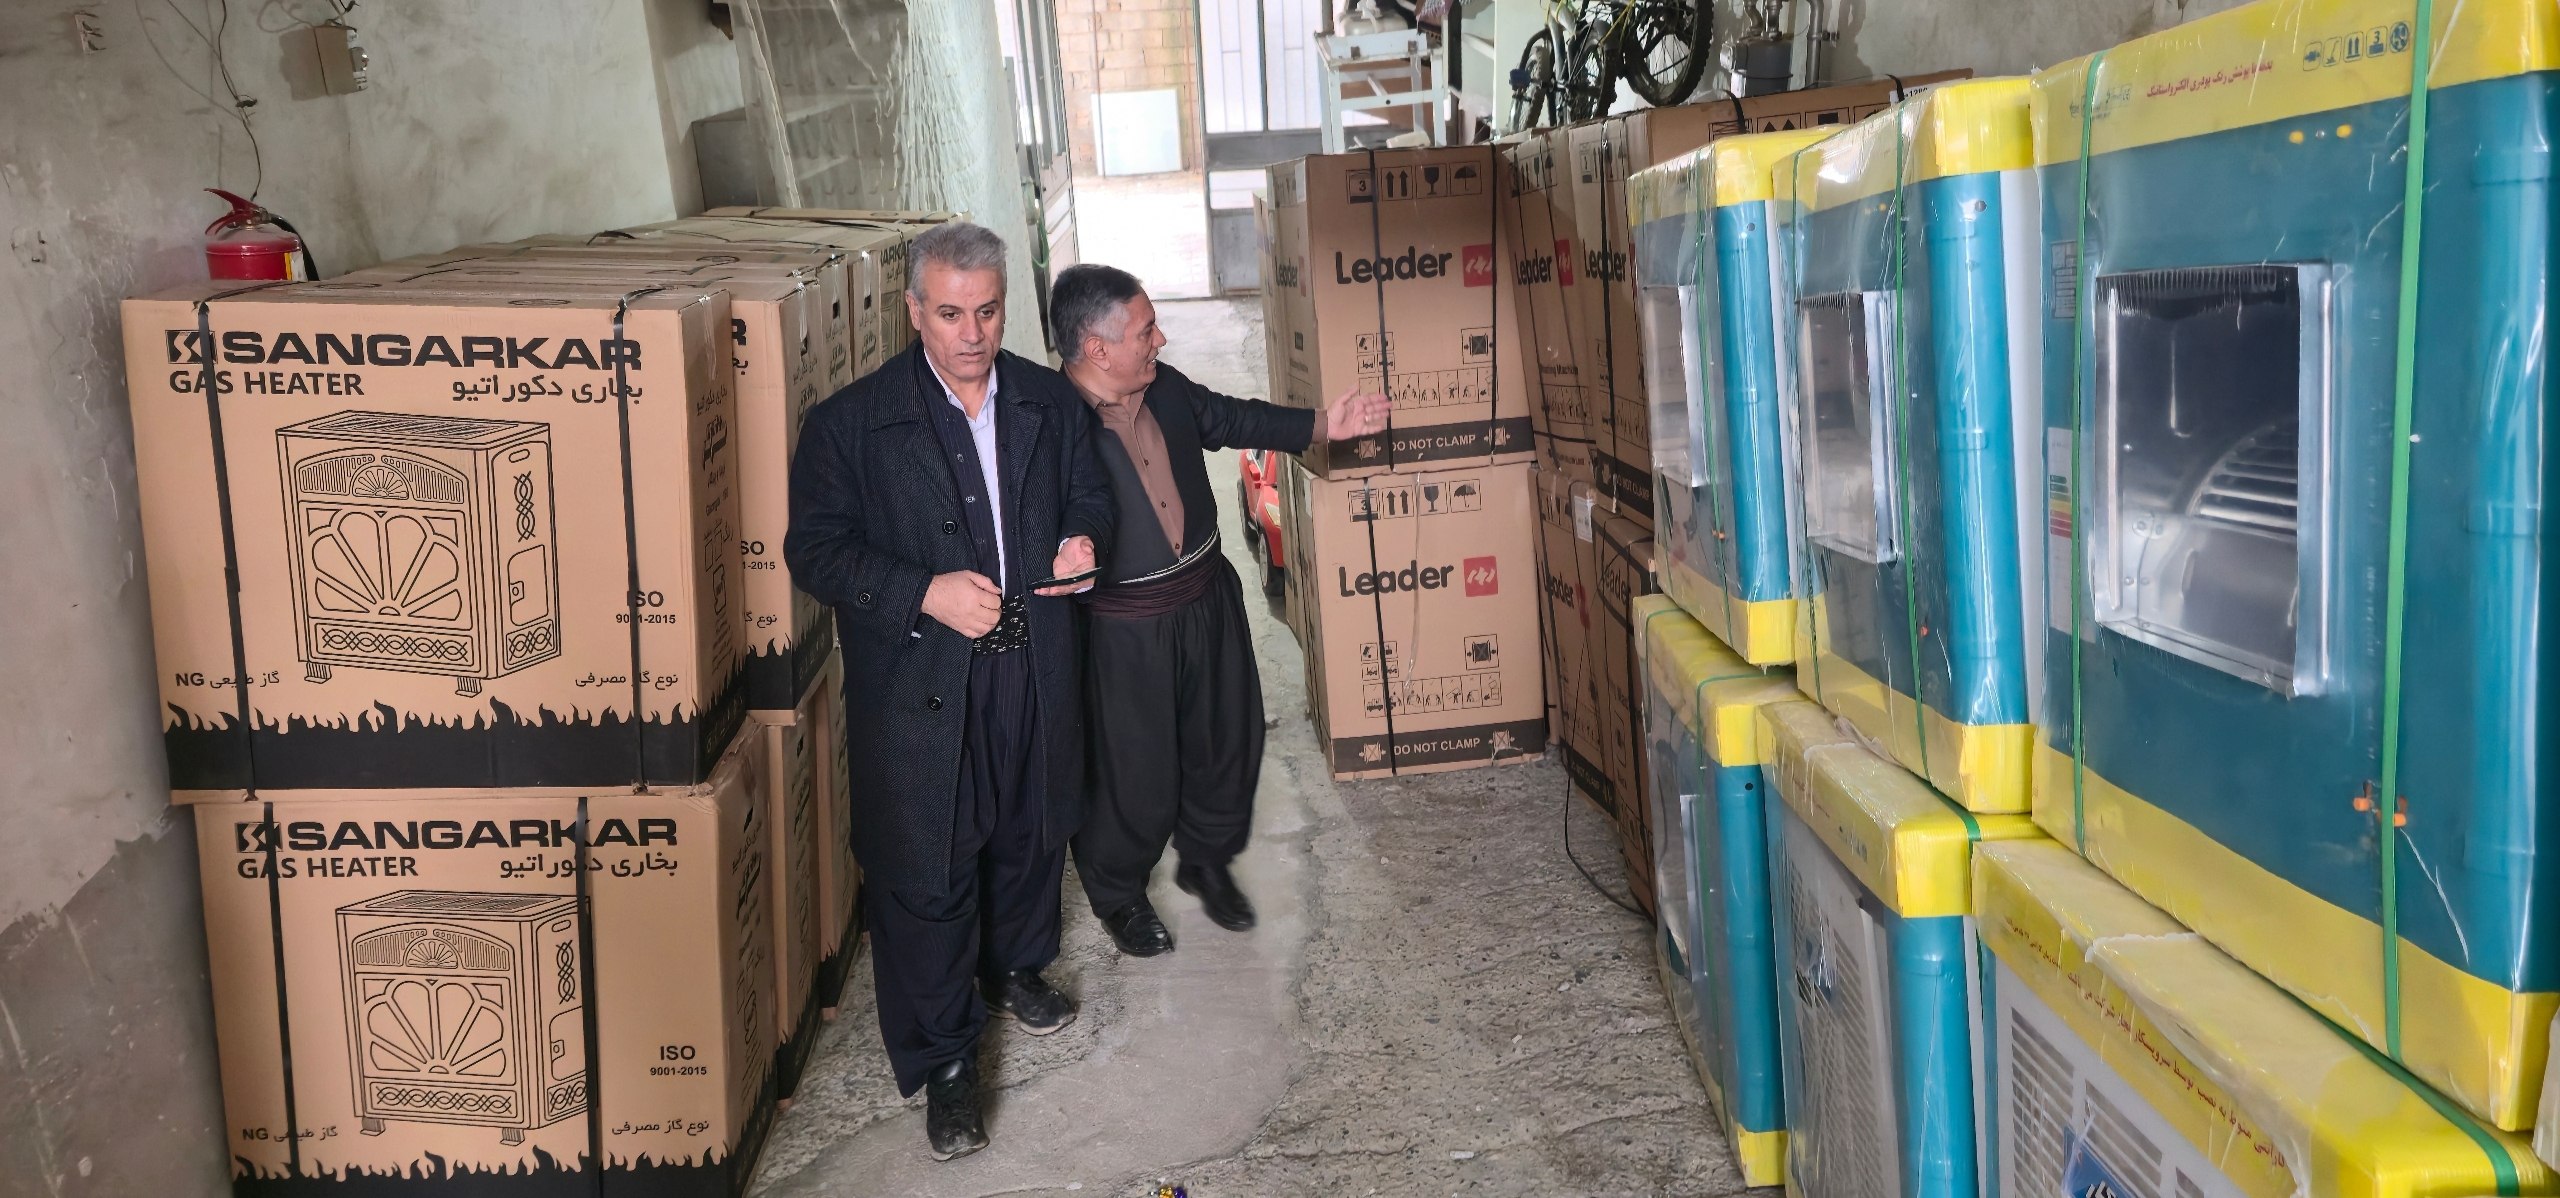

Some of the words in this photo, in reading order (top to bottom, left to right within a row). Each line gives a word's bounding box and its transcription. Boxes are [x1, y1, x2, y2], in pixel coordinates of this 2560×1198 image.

[1335, 246, 1453, 285] Leader
[1515, 248, 1553, 286] Leader
[222, 330, 642, 370] SANGARKAR
[244, 371, 365, 396] HEATER
[452, 374, 563, 403] دکوراتیو
[1409, 438, 1433, 451] NOT
[1435, 434, 1476, 448] CLAMP
[741, 541, 765, 556] SO
[742, 561, 776, 570] 1-2015
[1339, 559, 1455, 598] Leader
[1541, 560, 1575, 610] Lader
[615, 613, 677, 625] 901-2015
[756, 614, 778, 629] نوع
[175, 672, 205, 687] NG
[210, 676, 254, 689] طیعی
[260, 670, 280, 688] گاز
[575, 671, 627, 687] مصرفی
[631, 670, 651, 688] گا
[654, 674, 679, 691] نوع
[1394, 745, 1411, 756] DO
[1414, 741, 1438, 754] NOT
[1440, 737, 1481, 750] CLAMP
[287, 818, 678, 850] SANGARKAR
[307, 856, 419, 878] HEATER
[500, 853, 604, 879] دوراتیو
[611, 851, 678, 878] بخاری
[660, 1045, 696, 1061] ISO
[649, 1066, 707, 1076] 9001-2015
[242, 1127, 269, 1141] NG
[319, 1125, 339, 1141] گاز
[611, 1121, 660, 1135] مصرفی
[664, 1118, 683, 1134] گاز
[686, 1119, 710, 1136] نوع
[273, 1128, 314, 1142] طبی
